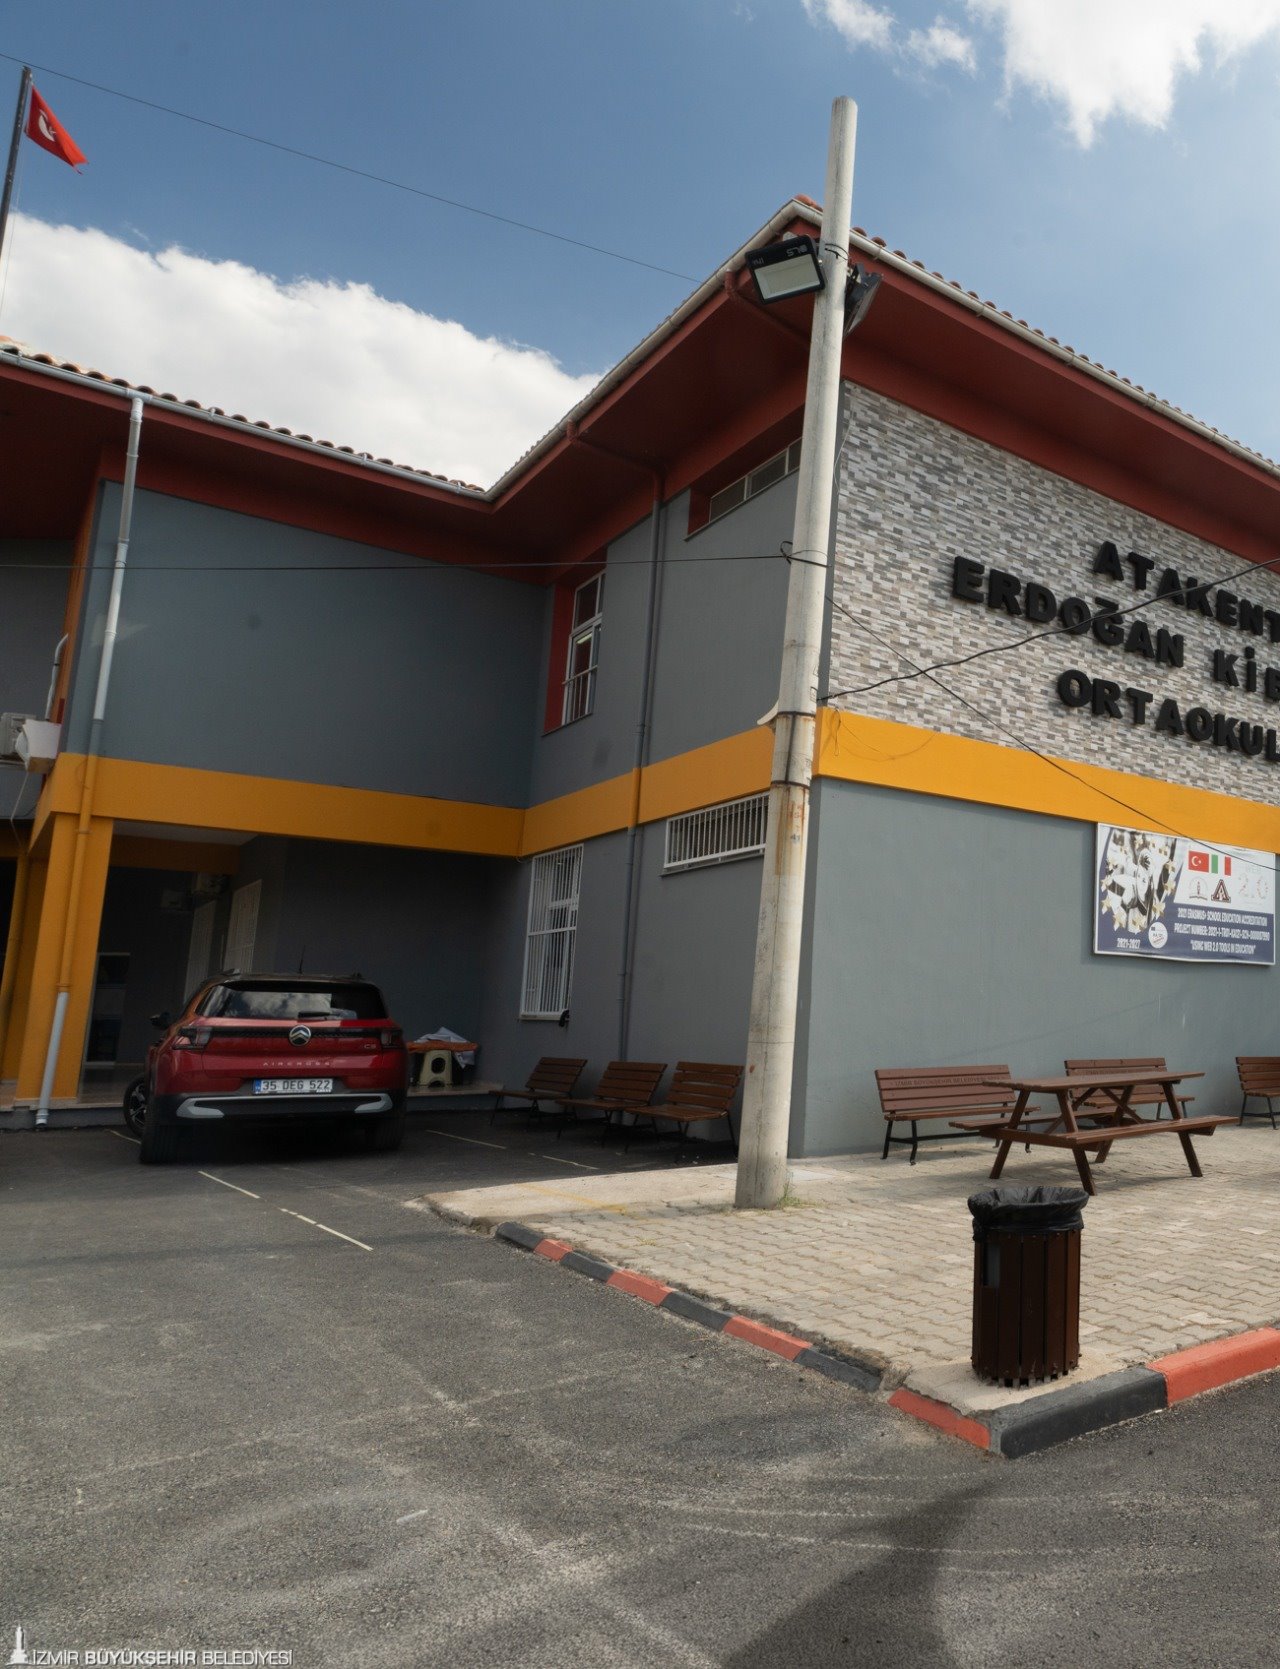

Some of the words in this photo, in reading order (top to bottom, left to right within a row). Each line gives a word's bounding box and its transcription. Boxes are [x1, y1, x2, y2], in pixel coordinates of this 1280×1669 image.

[953, 555, 1184, 668] ERDOĞAN
[262, 1080, 277, 1090] 35
[282, 1080, 304, 1090] DEG
[309, 1079, 330, 1090] 522
